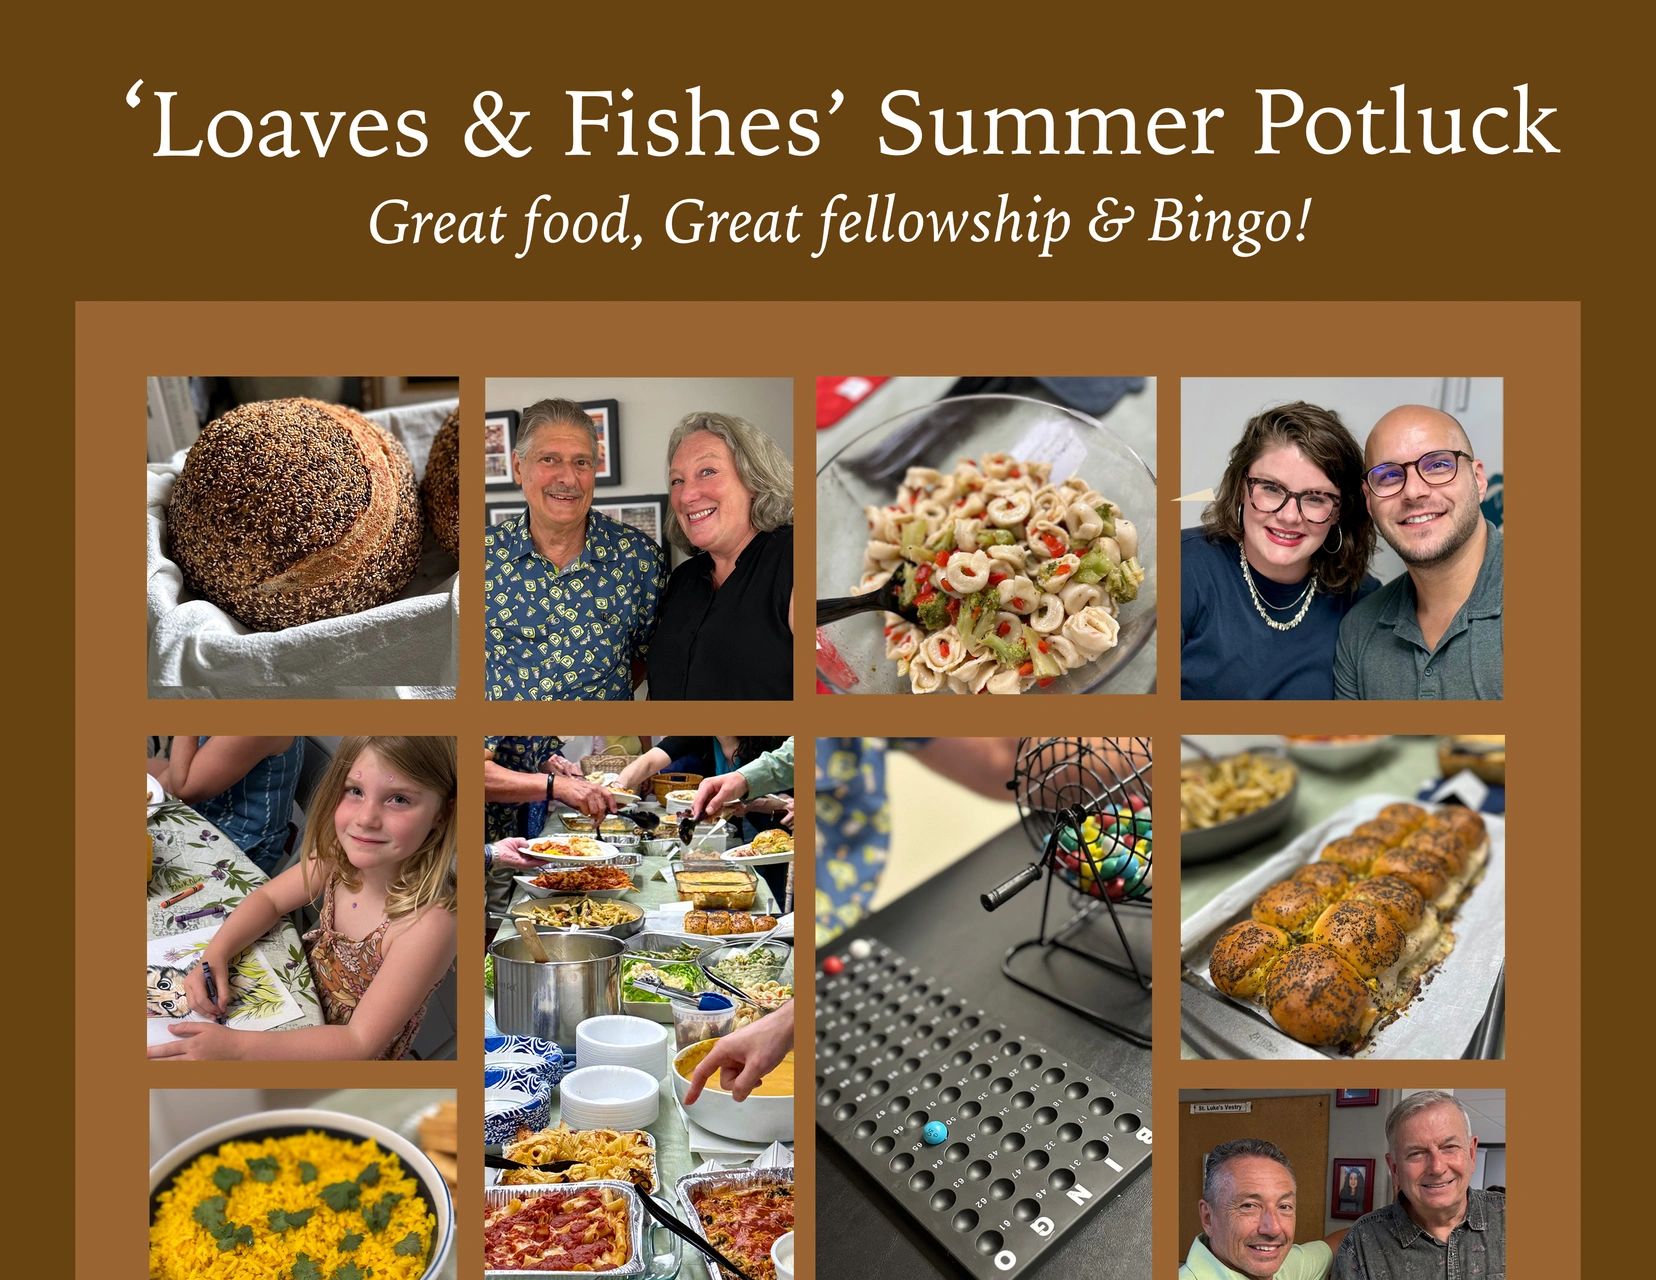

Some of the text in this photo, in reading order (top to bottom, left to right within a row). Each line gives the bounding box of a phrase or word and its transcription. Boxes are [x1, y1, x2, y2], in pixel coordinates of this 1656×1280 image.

[939, 1063, 950, 1073] 37
[1008, 1068, 1020, 1077] 20
[906, 1086, 919, 1095] 52
[1030, 1083, 1040, 1092] 19
[893, 1055, 999, 1135] 21 36 51 66
[977, 1091, 989, 1100] 35
[1052, 1099, 1063, 1107] 18
[1224, 1103, 1242, 1111] Vestry
[875, 1110, 886, 1119] 67
[998, 1106, 1010, 1116] 34
[945, 1116, 957, 1126] 50
[1077, 1115, 1088, 1124] 17
[1020, 1123, 1033, 1133] 33
[966, 1133, 976, 1142] 49
[1102, 1132, 1113, 1142] 16
[911, 1142, 923, 1152] 65
[1044, 1140, 1056, 1151] 32
[987, 1150, 999, 1160] 48
[932, 1159, 944, 1169] 64
[1069, 1159, 1082, 1170] 31
[1011, 1168, 1022, 1179] 47
[953, 1177, 965, 1188] 63
[993, 1126, 1153, 1271] B I N G O
[1035, 1188, 1047, 1199] 46
[975, 1197, 988, 1209] 62
[999, 1219, 1011, 1231] 61
